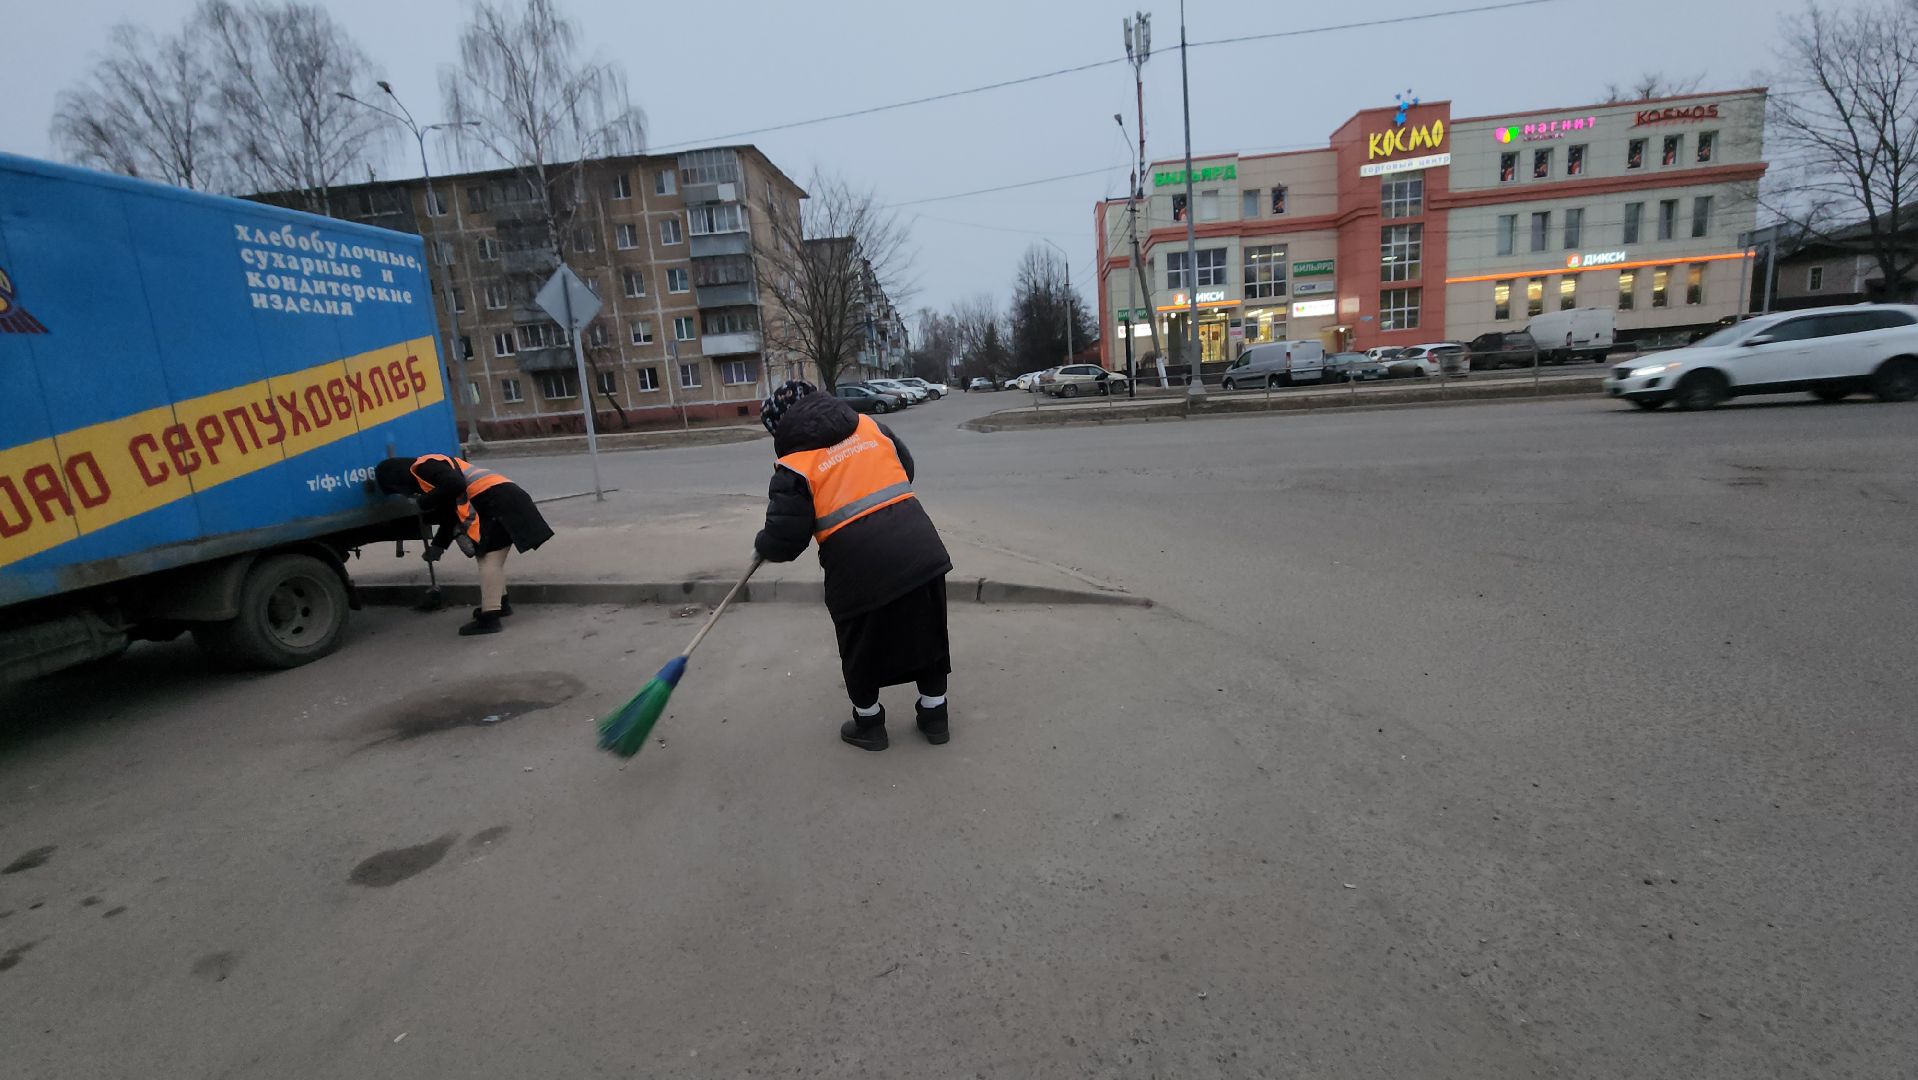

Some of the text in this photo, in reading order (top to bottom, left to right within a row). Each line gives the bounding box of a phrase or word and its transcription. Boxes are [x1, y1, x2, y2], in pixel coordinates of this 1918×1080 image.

[1634, 104, 1719, 127] KOSMOS
[1369, 119, 1444, 160] КОСМО
[234, 224, 422, 272] хлебобулочные,
[1582, 251, 1626, 266] ДИКСИ
[240, 248, 394, 283] сухарные и
[1294, 261, 1334, 273] БИЛЬЯРД
[245, 271, 413, 304] кондитерские
[1187, 291, 1225, 305] ИКСИ
[251, 292, 354, 316] изделия
[343, 466, 377, 489] (496
[0, 450, 112, 540] ОАО
